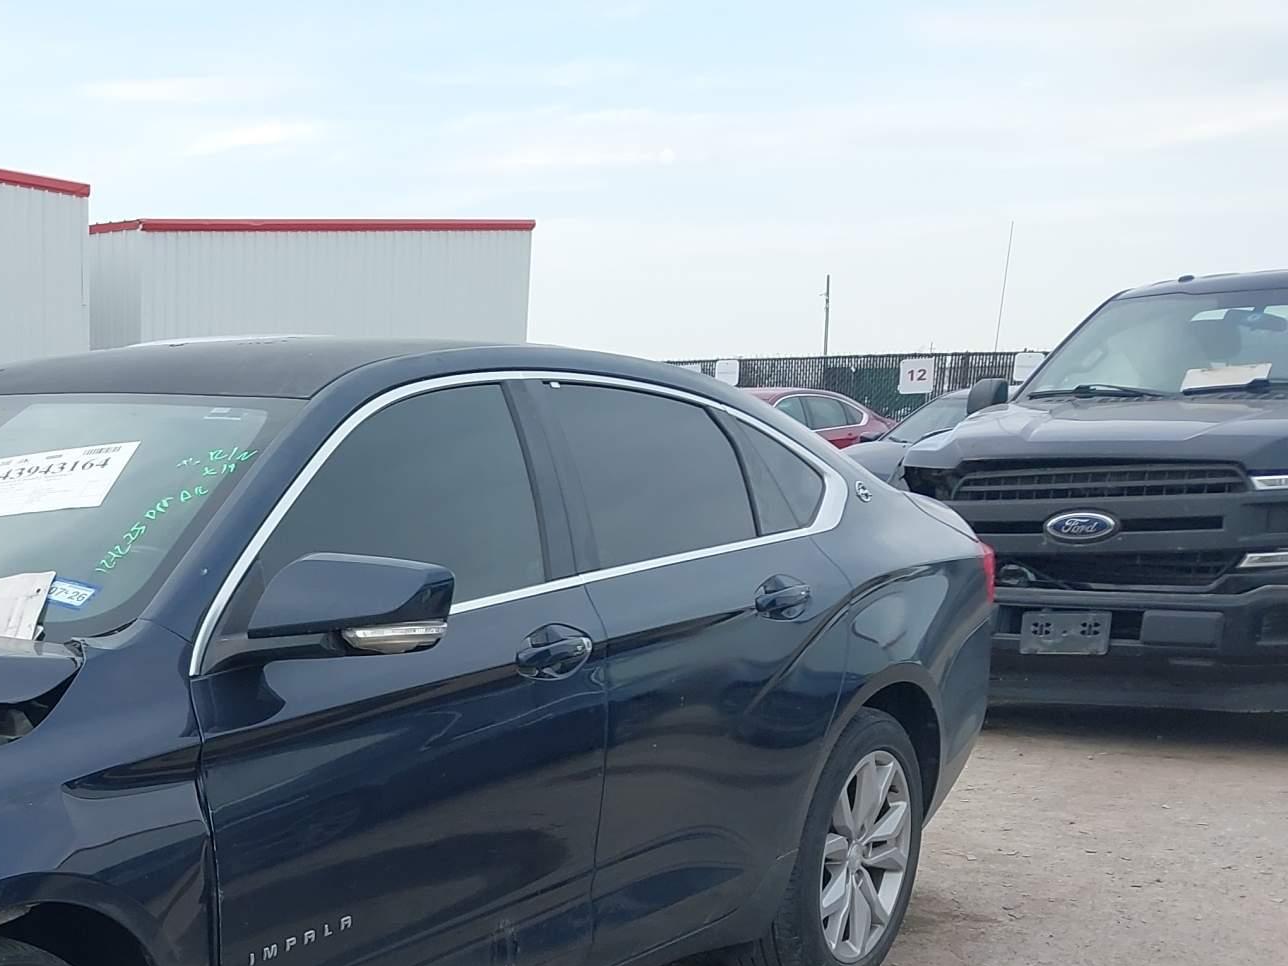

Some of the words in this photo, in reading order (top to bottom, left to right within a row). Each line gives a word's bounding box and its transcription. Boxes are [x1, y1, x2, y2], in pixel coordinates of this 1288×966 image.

[906, 368, 928, 382] 12
[1061, 518, 1098, 534] Ford
[248, 915, 353, 966] IMPALA
